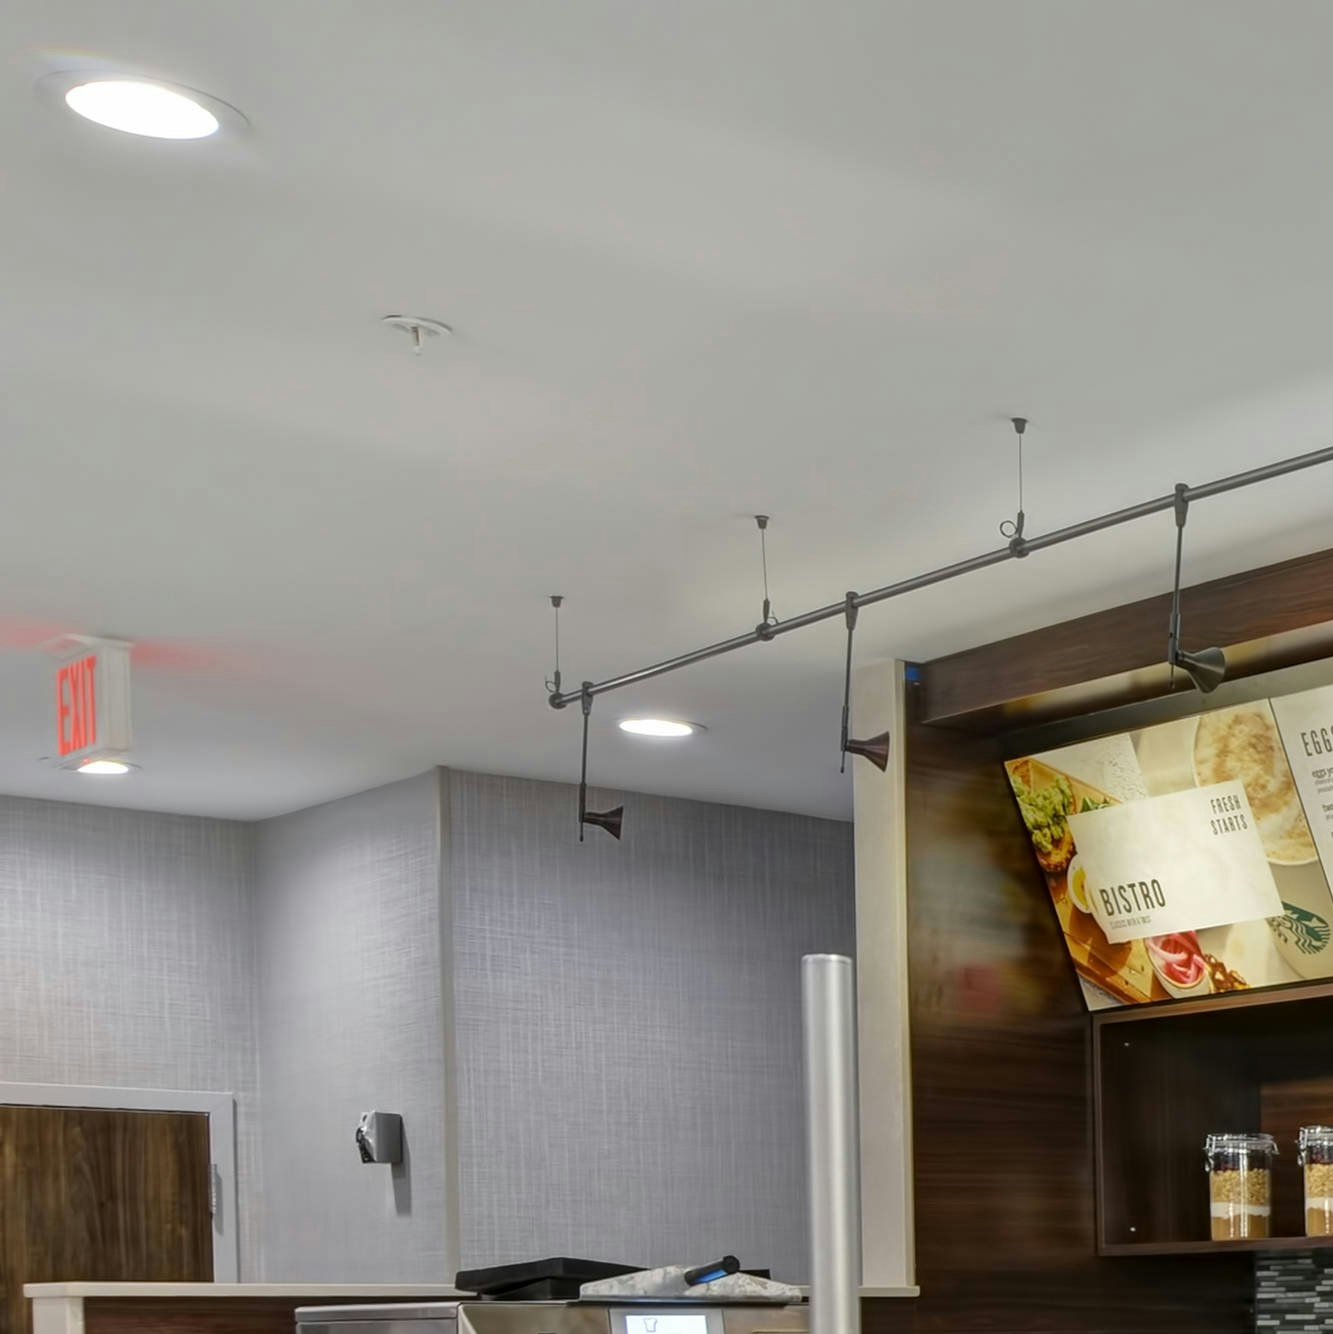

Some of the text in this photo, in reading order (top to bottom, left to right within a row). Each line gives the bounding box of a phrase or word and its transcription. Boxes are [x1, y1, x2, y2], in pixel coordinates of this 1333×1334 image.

[56, 654, 97, 758] EXIT
[1210, 794, 1242, 815] FRESH
[1210, 814, 1249, 836] STARTS
[1099, 878, 1167, 917] BISTRO
